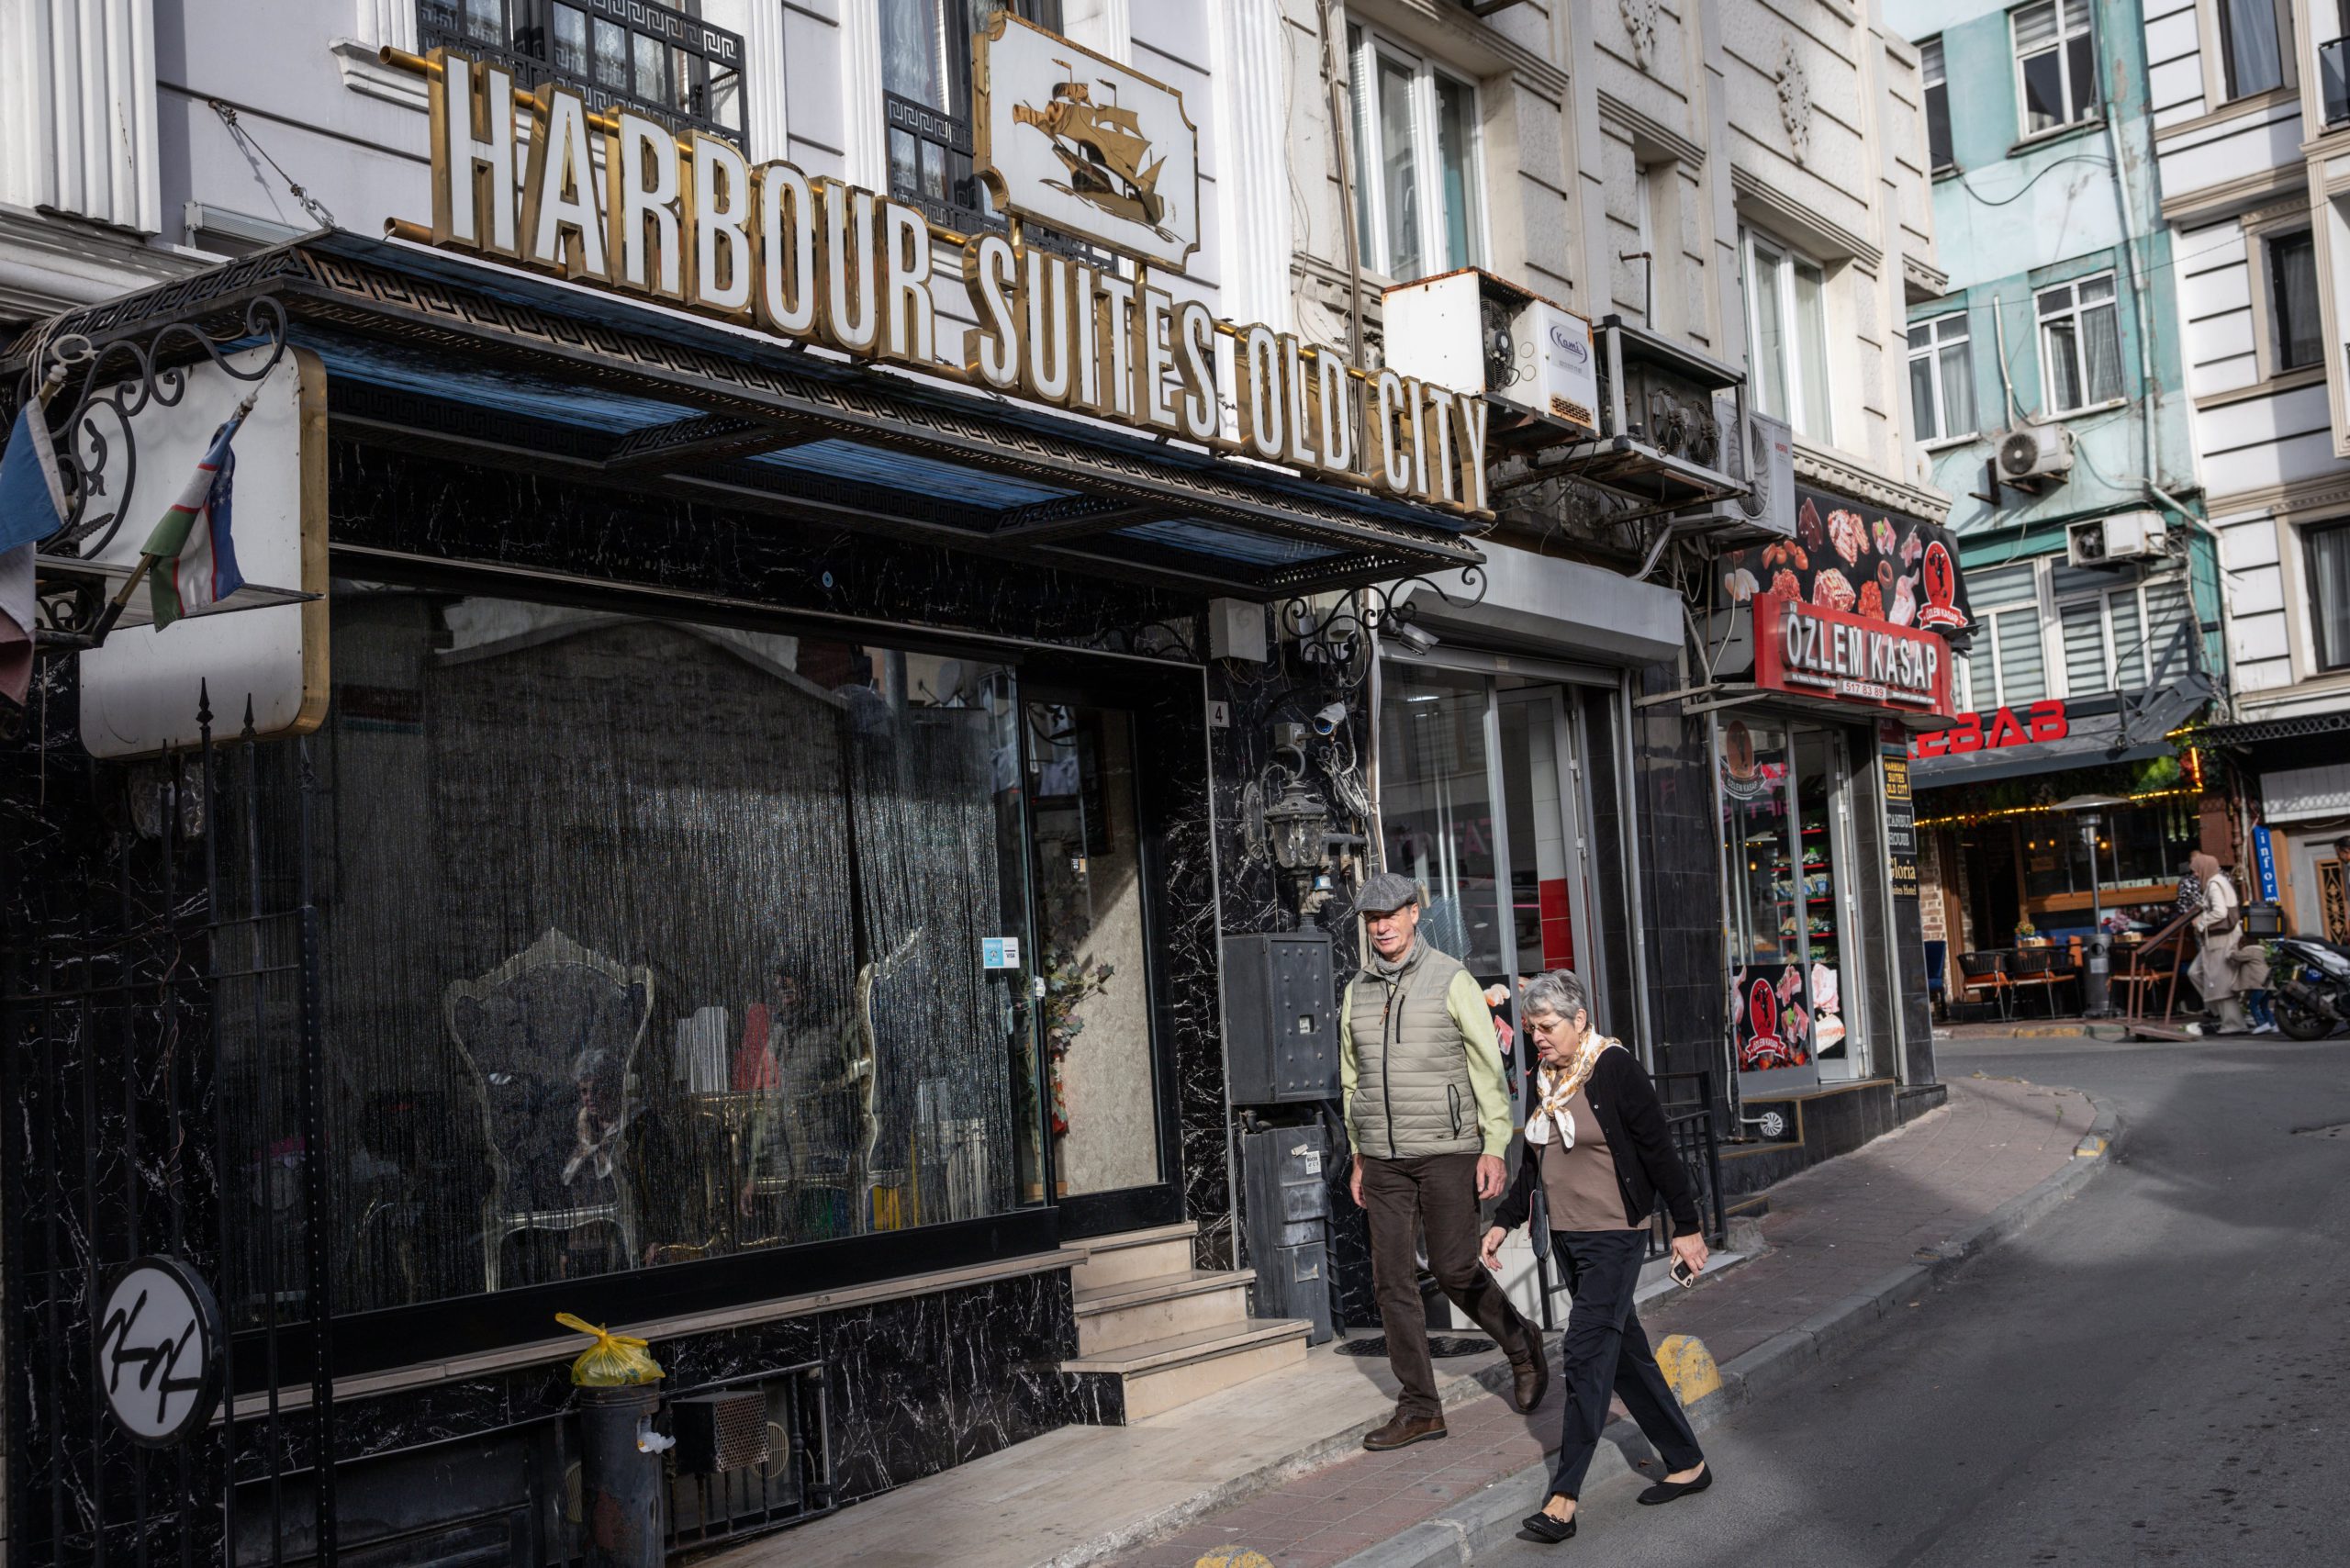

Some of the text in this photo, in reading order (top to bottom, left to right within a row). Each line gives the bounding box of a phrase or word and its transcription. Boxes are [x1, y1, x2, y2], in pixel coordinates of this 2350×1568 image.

[430, 47, 1488, 514] HARBOUR SUITES OLD CITY
[1784, 602, 1938, 690] ÖZLEM KASAP
[1845, 682, 1884, 697] 517 83 89
[1215, 705, 1223, 722] 4
[1908, 700, 2068, 760] EBAB
[1885, 761, 1907, 772] HARBOUR
[1887, 772, 1905, 783] SUITES
[1886, 784, 1908, 794] OLD CITY
[1904, 884, 1917, 895] Hotel
